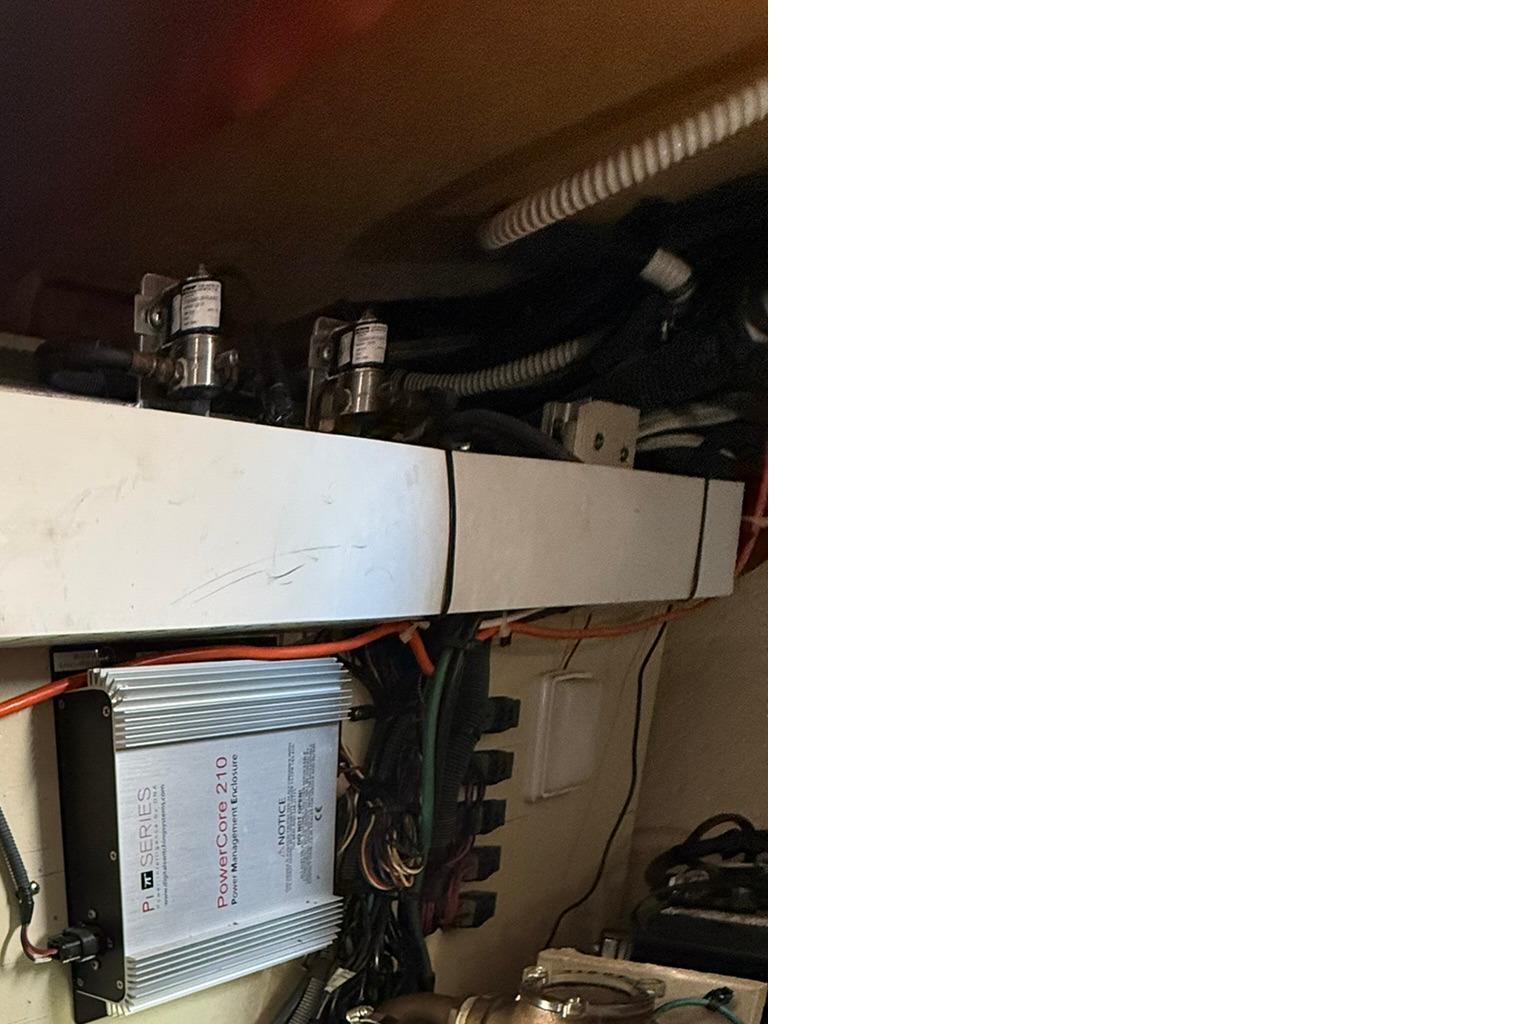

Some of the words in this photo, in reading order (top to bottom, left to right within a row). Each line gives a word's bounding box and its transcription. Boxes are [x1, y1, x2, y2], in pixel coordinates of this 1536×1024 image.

[215, 756, 228, 794] 210
[137, 787, 154, 867] SERIES
[216, 801, 228, 909] PowerCore
[231, 806, 239, 873] Management
[278, 798, 286, 846] NOTICE
